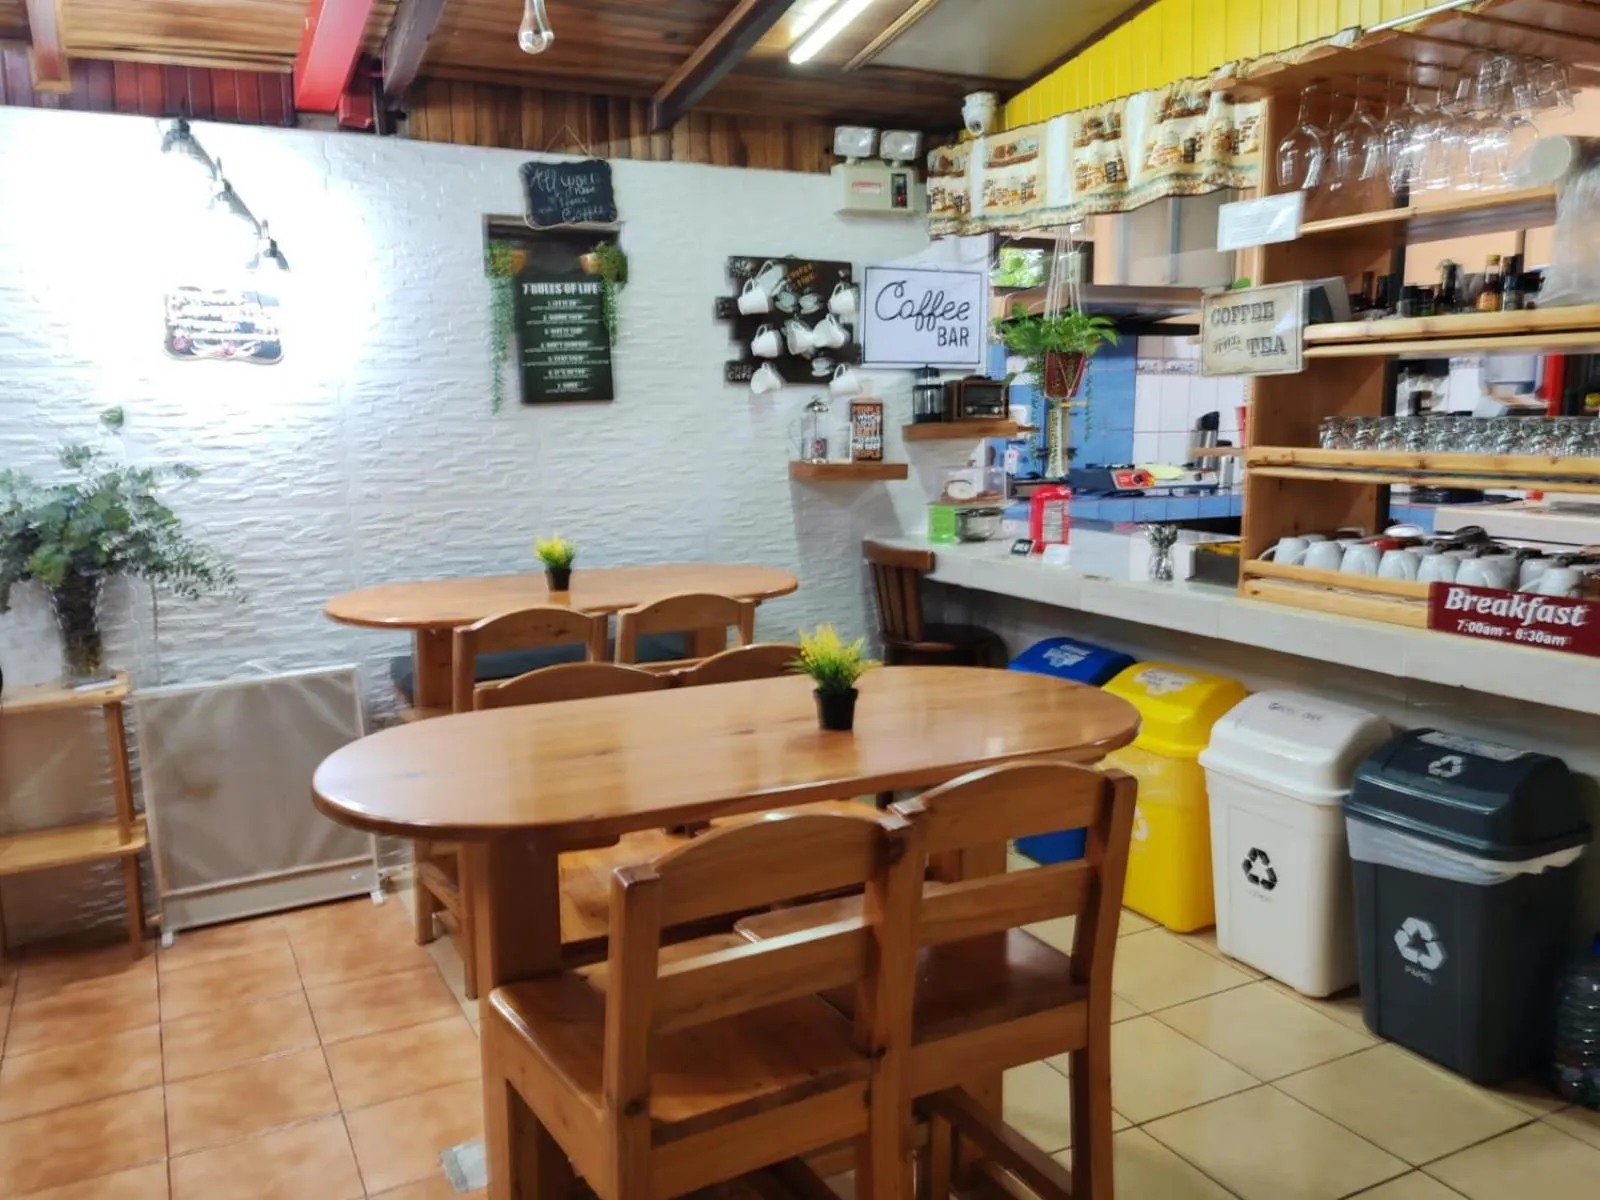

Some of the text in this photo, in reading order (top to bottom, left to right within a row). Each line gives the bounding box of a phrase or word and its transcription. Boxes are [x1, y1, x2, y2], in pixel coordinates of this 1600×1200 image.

[875, 280, 970, 332] Coffee
[1211, 301, 1275, 326] COFFEE
[938, 326, 969, 347] BAR
[1246, 335, 1287, 357] TEA
[1444, 587, 1591, 626] Breakfast
[1457, 619, 1503, 637] 7:00am
